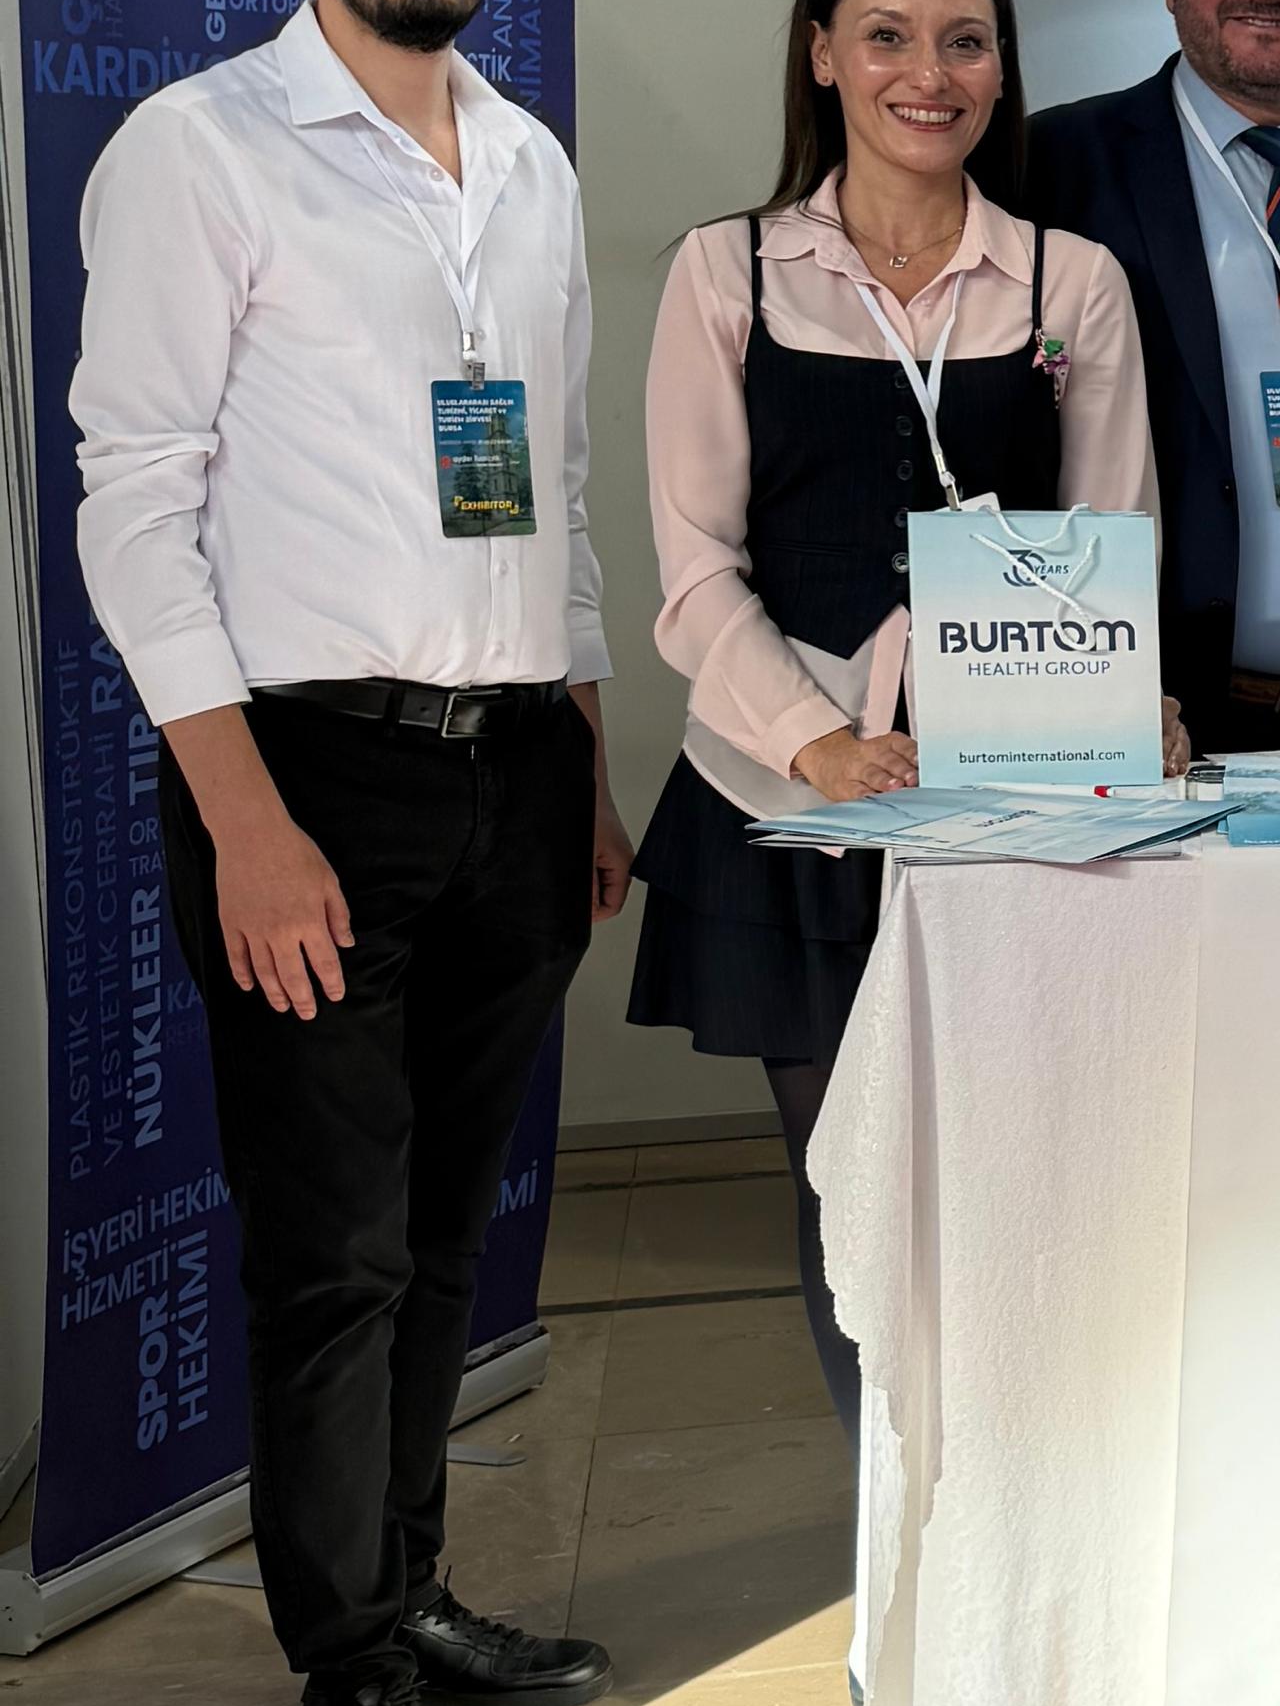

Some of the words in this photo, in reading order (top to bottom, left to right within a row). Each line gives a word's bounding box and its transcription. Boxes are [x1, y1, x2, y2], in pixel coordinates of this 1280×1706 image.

[461, 500, 513, 511] EXHIBITOR
[938, 620, 1136, 654] BURTOM
[967, 662, 1039, 676] HEALTH
[1045, 660, 1111, 676] GROUP
[128, 712, 160, 806] TIP
[958, 748, 1125, 764] burtominternational.com
[88, 729, 118, 923] CERRAHİ
[93, 936, 123, 1101] ESTETİK
[126, 883, 164, 1150] NÜKLEER
[63, 1006, 91, 1182] PLASTİK
[103, 1107, 124, 1167] VE
[60, 1238, 169, 1332] HİZMETİ
[63, 1195, 144, 1281] İŞYERİ
[136, 1289, 169, 1451] SPOR
[170, 1229, 208, 1432] HEKİMİ
